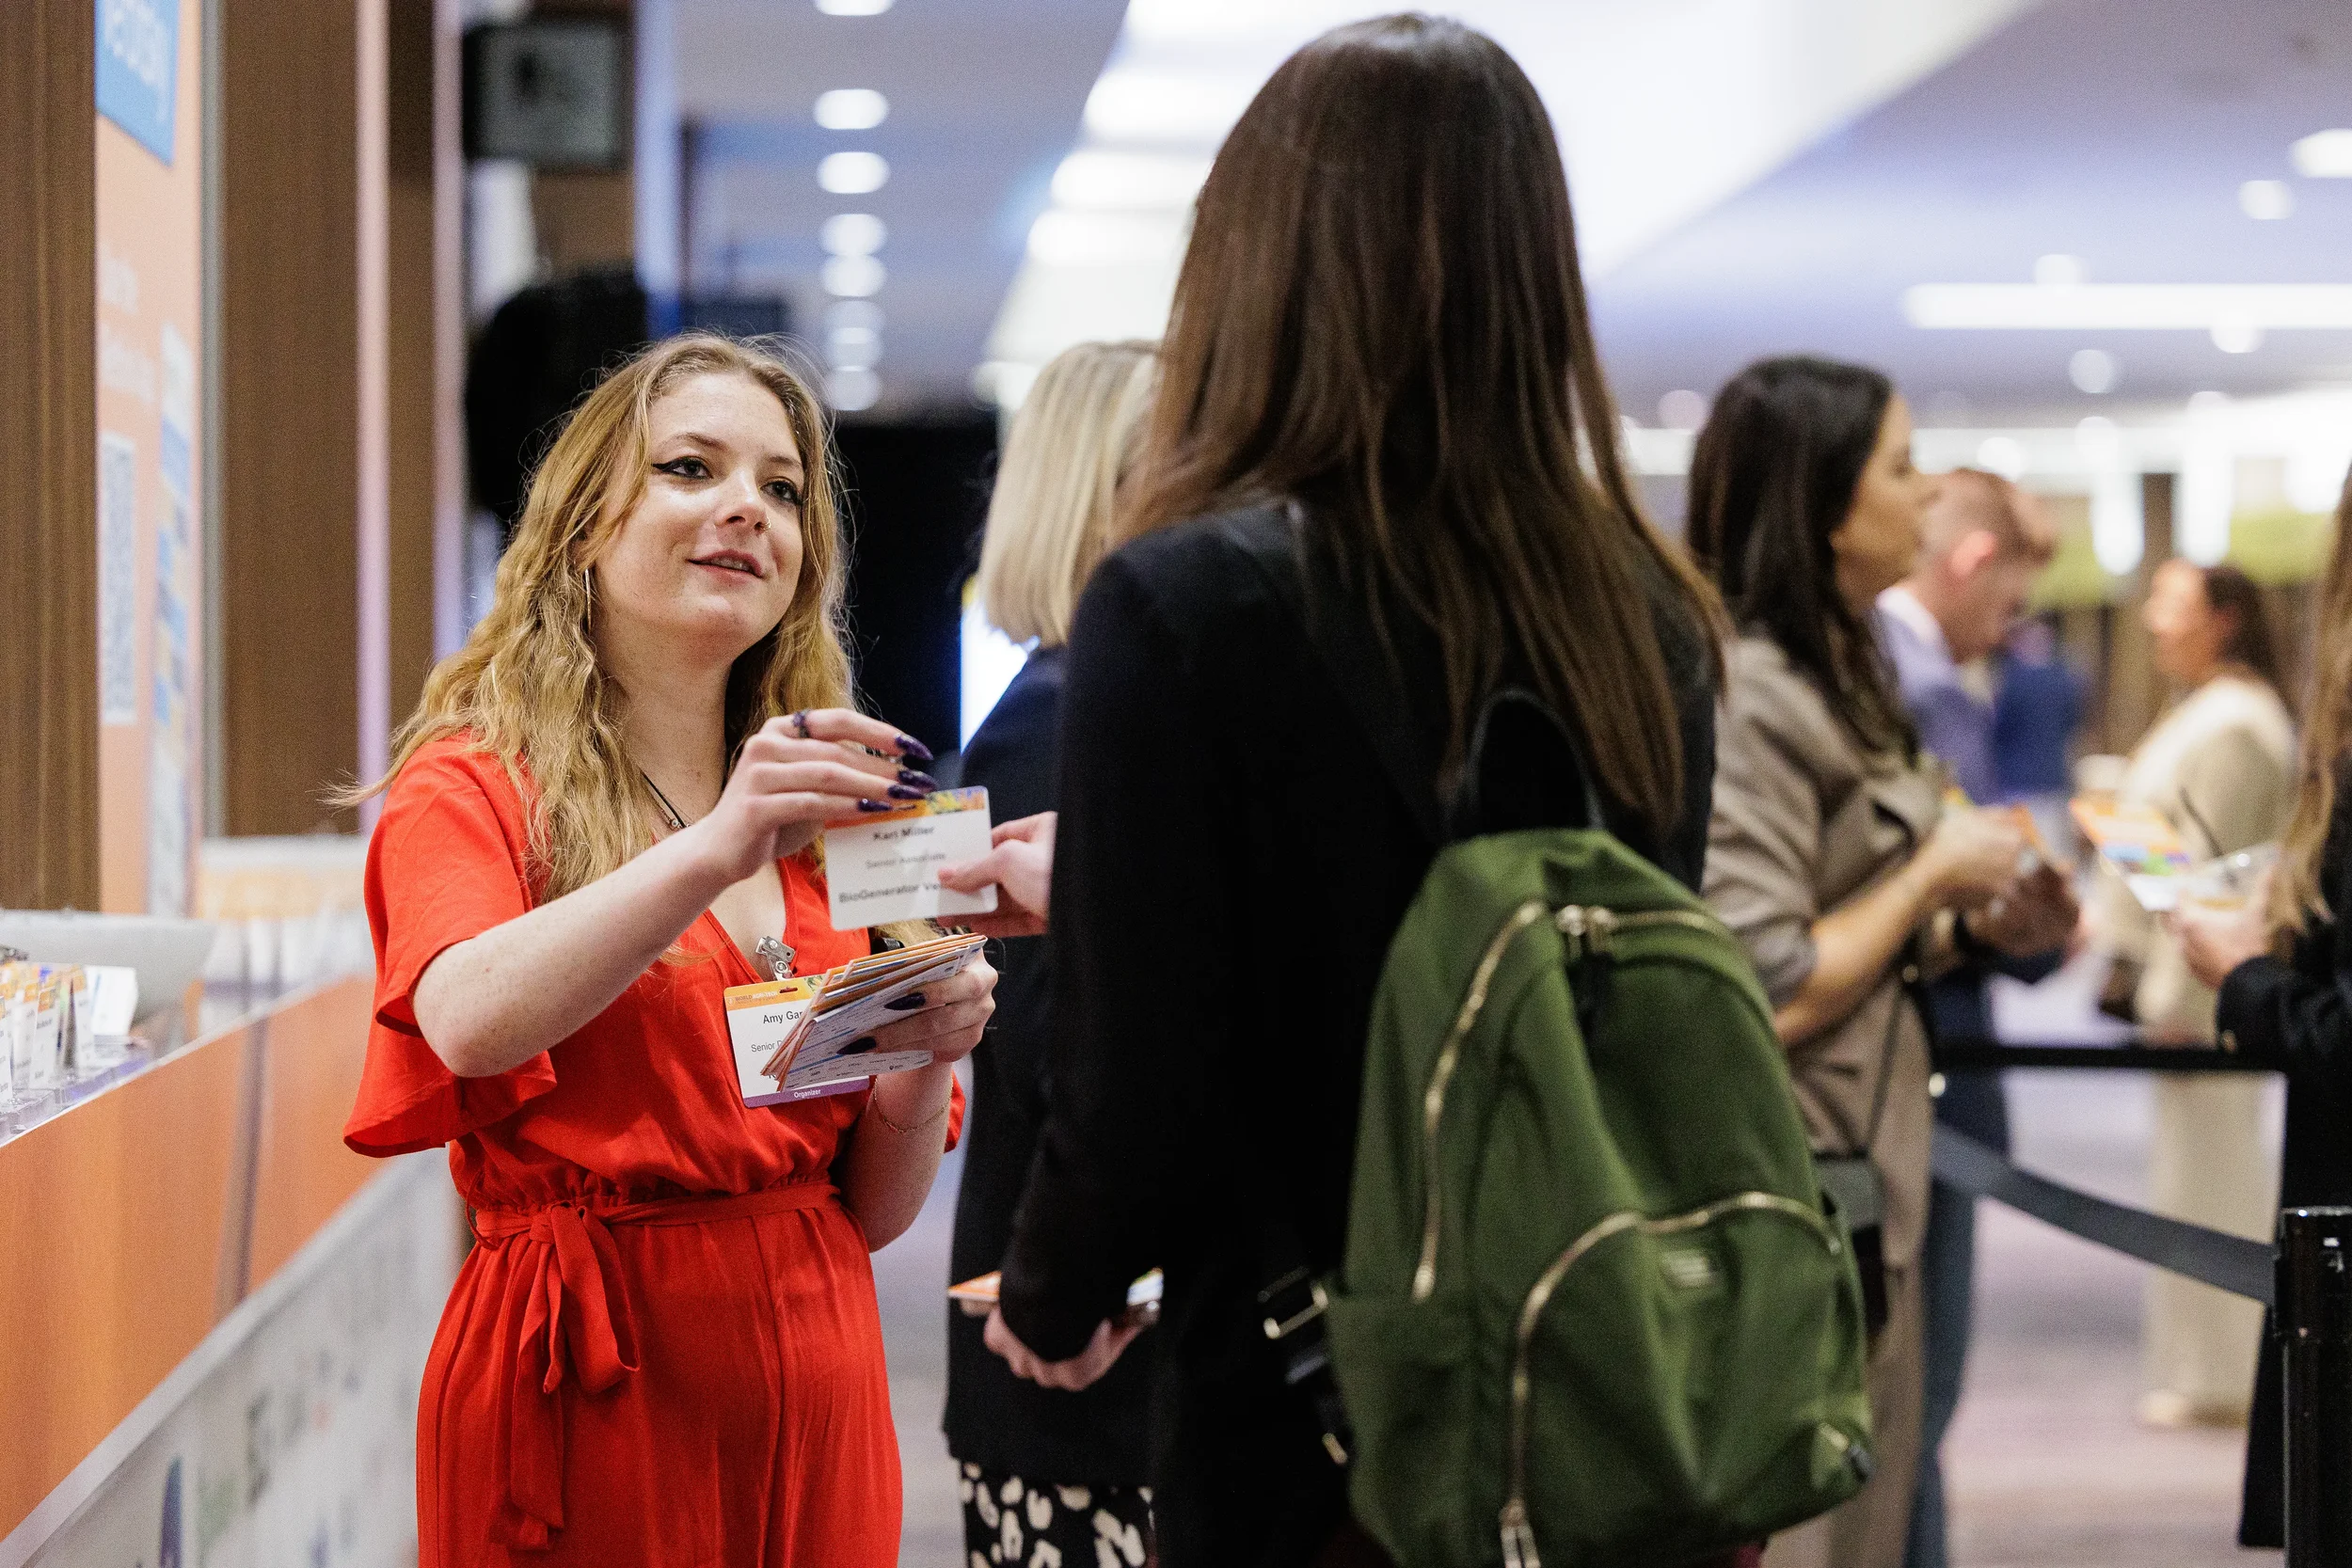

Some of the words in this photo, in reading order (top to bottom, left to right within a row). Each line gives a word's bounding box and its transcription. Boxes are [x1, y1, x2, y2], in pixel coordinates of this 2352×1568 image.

[839, 885, 918, 903] BioGenerator
[923, 882, 940, 891] Ve
[763, 1013, 784, 1023] Amy
[751, 1042, 775, 1053] Senior
[793, 1088, 821, 1099] Organizer
